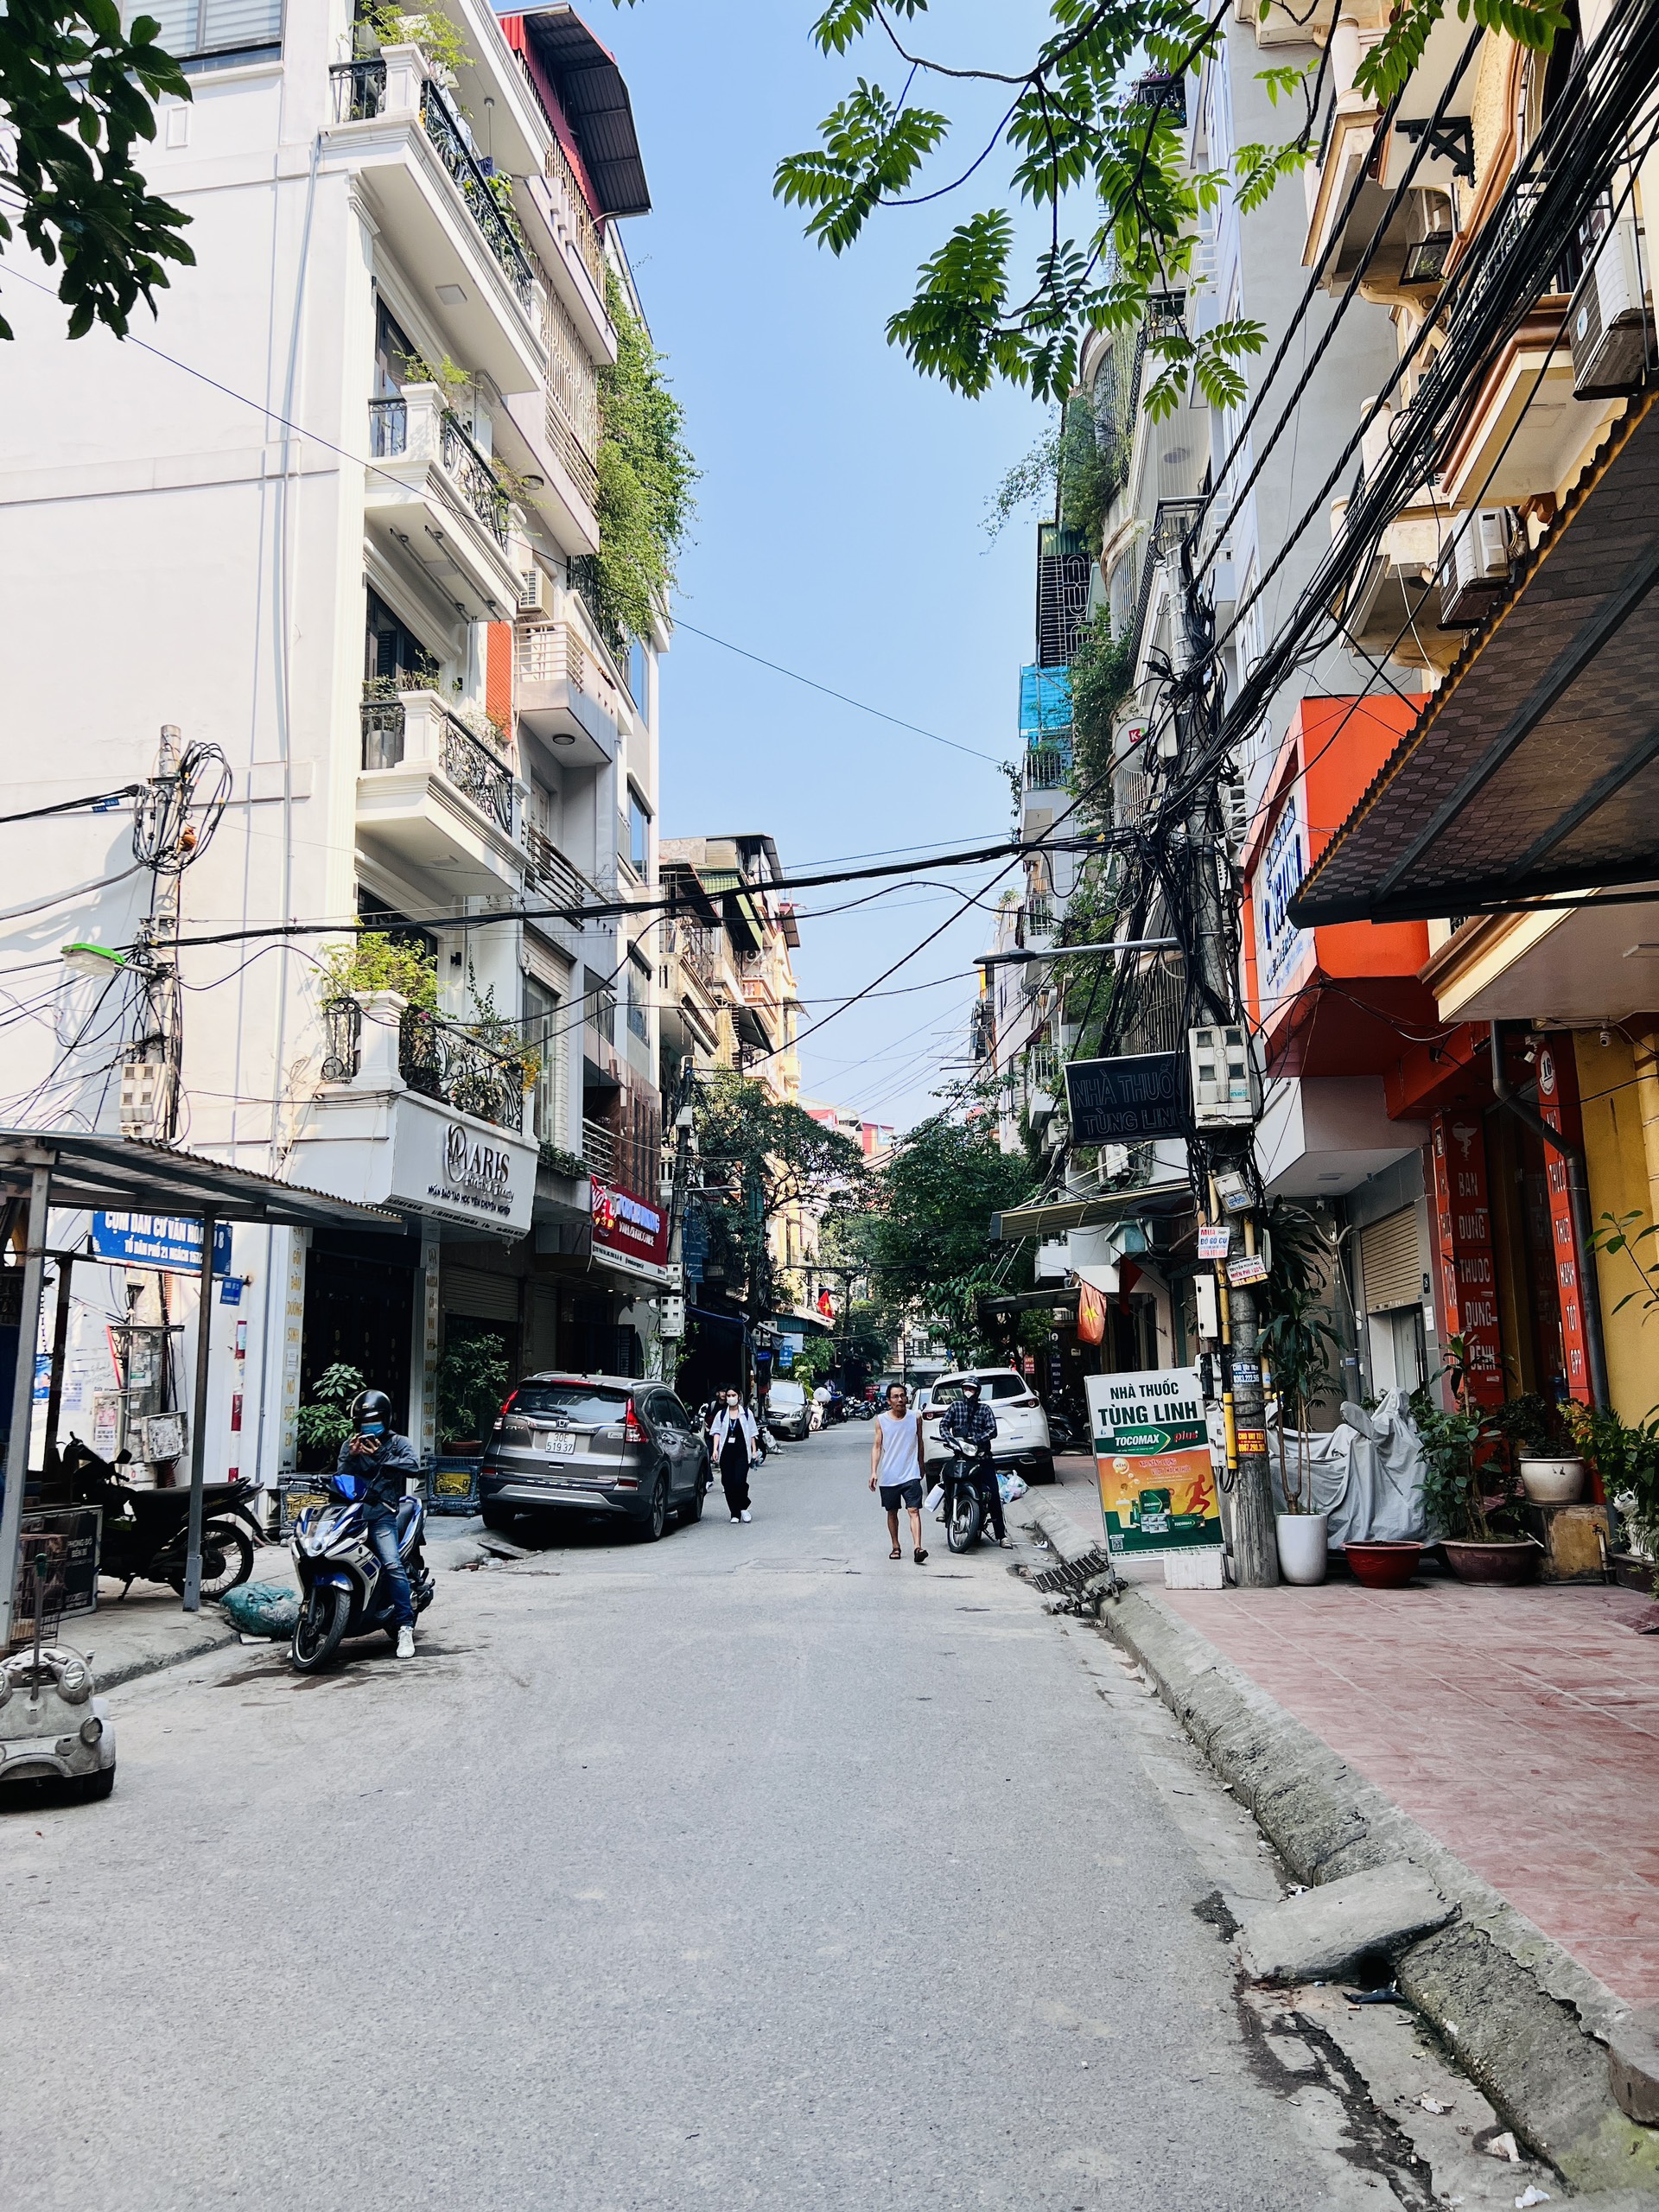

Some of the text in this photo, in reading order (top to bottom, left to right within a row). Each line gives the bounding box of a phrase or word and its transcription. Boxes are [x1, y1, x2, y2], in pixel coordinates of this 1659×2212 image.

[1542, 1057, 1552, 1078] 16
[1071, 1063, 1181, 1109] NHÀ THUỐ
[1083, 1106, 1178, 1136] TÙNG LIN
[461, 1193, 470, 1206] HỌC
[105, 1211, 129, 1234] CỤM
[154, 1217, 168, 1237] CƯ
[168, 1217, 186, 1242] VĂN
[219, 1231, 225, 1249] 8
[124, 1235, 134, 1253] TỔ
[1110, 1378, 1179, 1400] NHÀ THUỐC
[1098, 1401, 1198, 1426] TÙNG LINH
[555, 1433, 569, 1442] 30E
[1116, 1430, 1198, 1446] TOCOMAX plus
